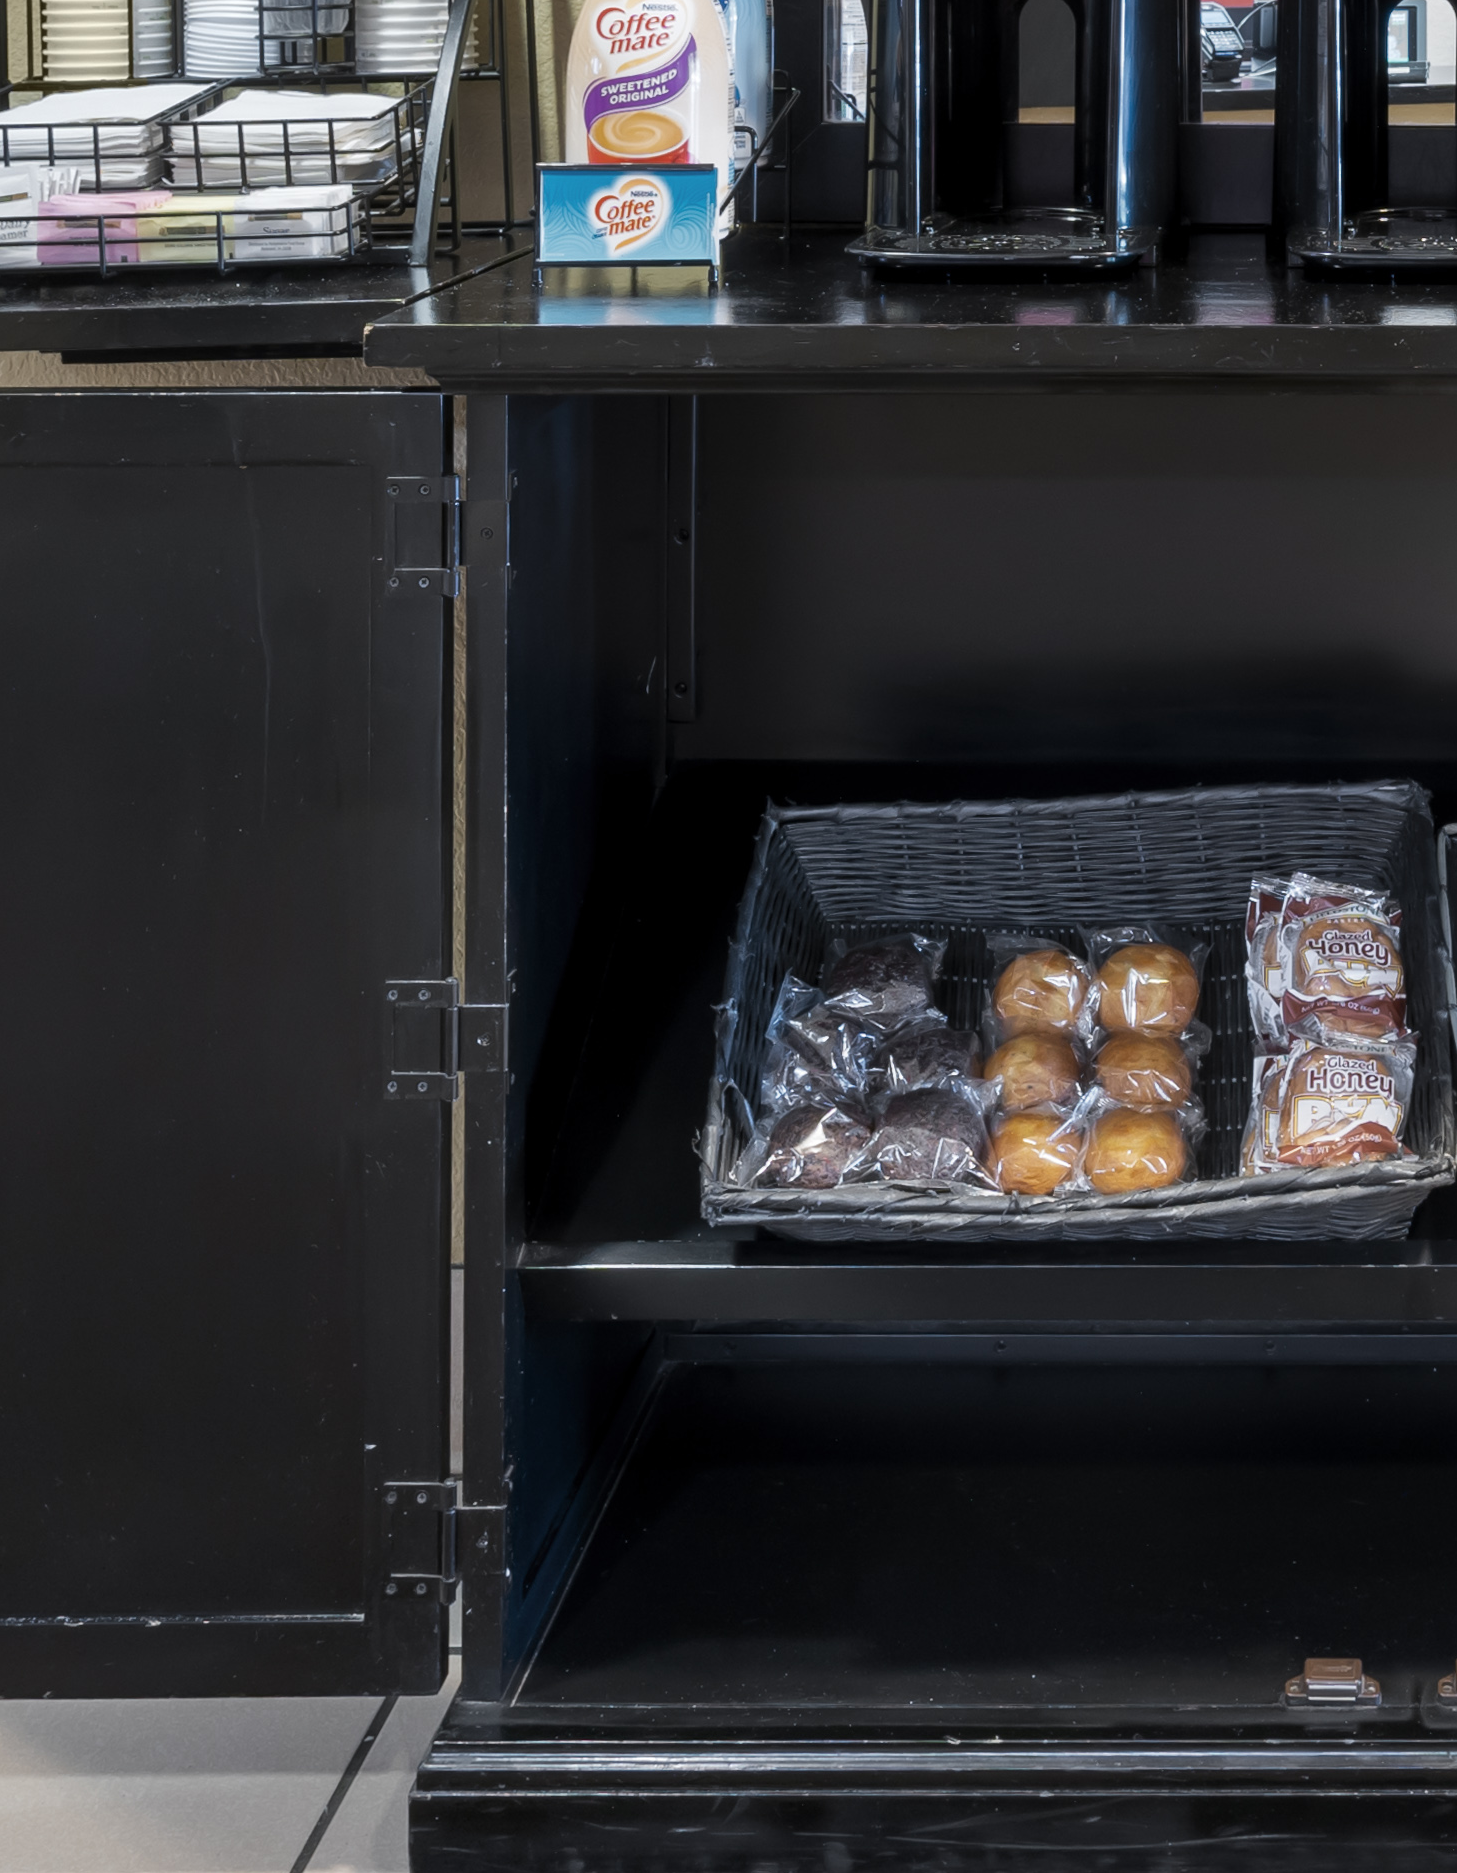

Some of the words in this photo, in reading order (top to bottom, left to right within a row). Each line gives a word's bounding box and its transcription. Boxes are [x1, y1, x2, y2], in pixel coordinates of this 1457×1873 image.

[596, 7, 676, 41] Coffee
[609, 32, 670, 55] mate
[600, 68, 678, 97] SWEETENED
[609, 85, 670, 105] ORIGINAL
[594, 194, 655, 224] Coffee
[608, 215, 651, 236] mate
[1323, 930, 1371, 942] Glazed
[1308, 939, 1390, 967] Honey
[1327, 1056, 1376, 1072] Glazed
[1308, 1068, 1394, 1100] Honey
